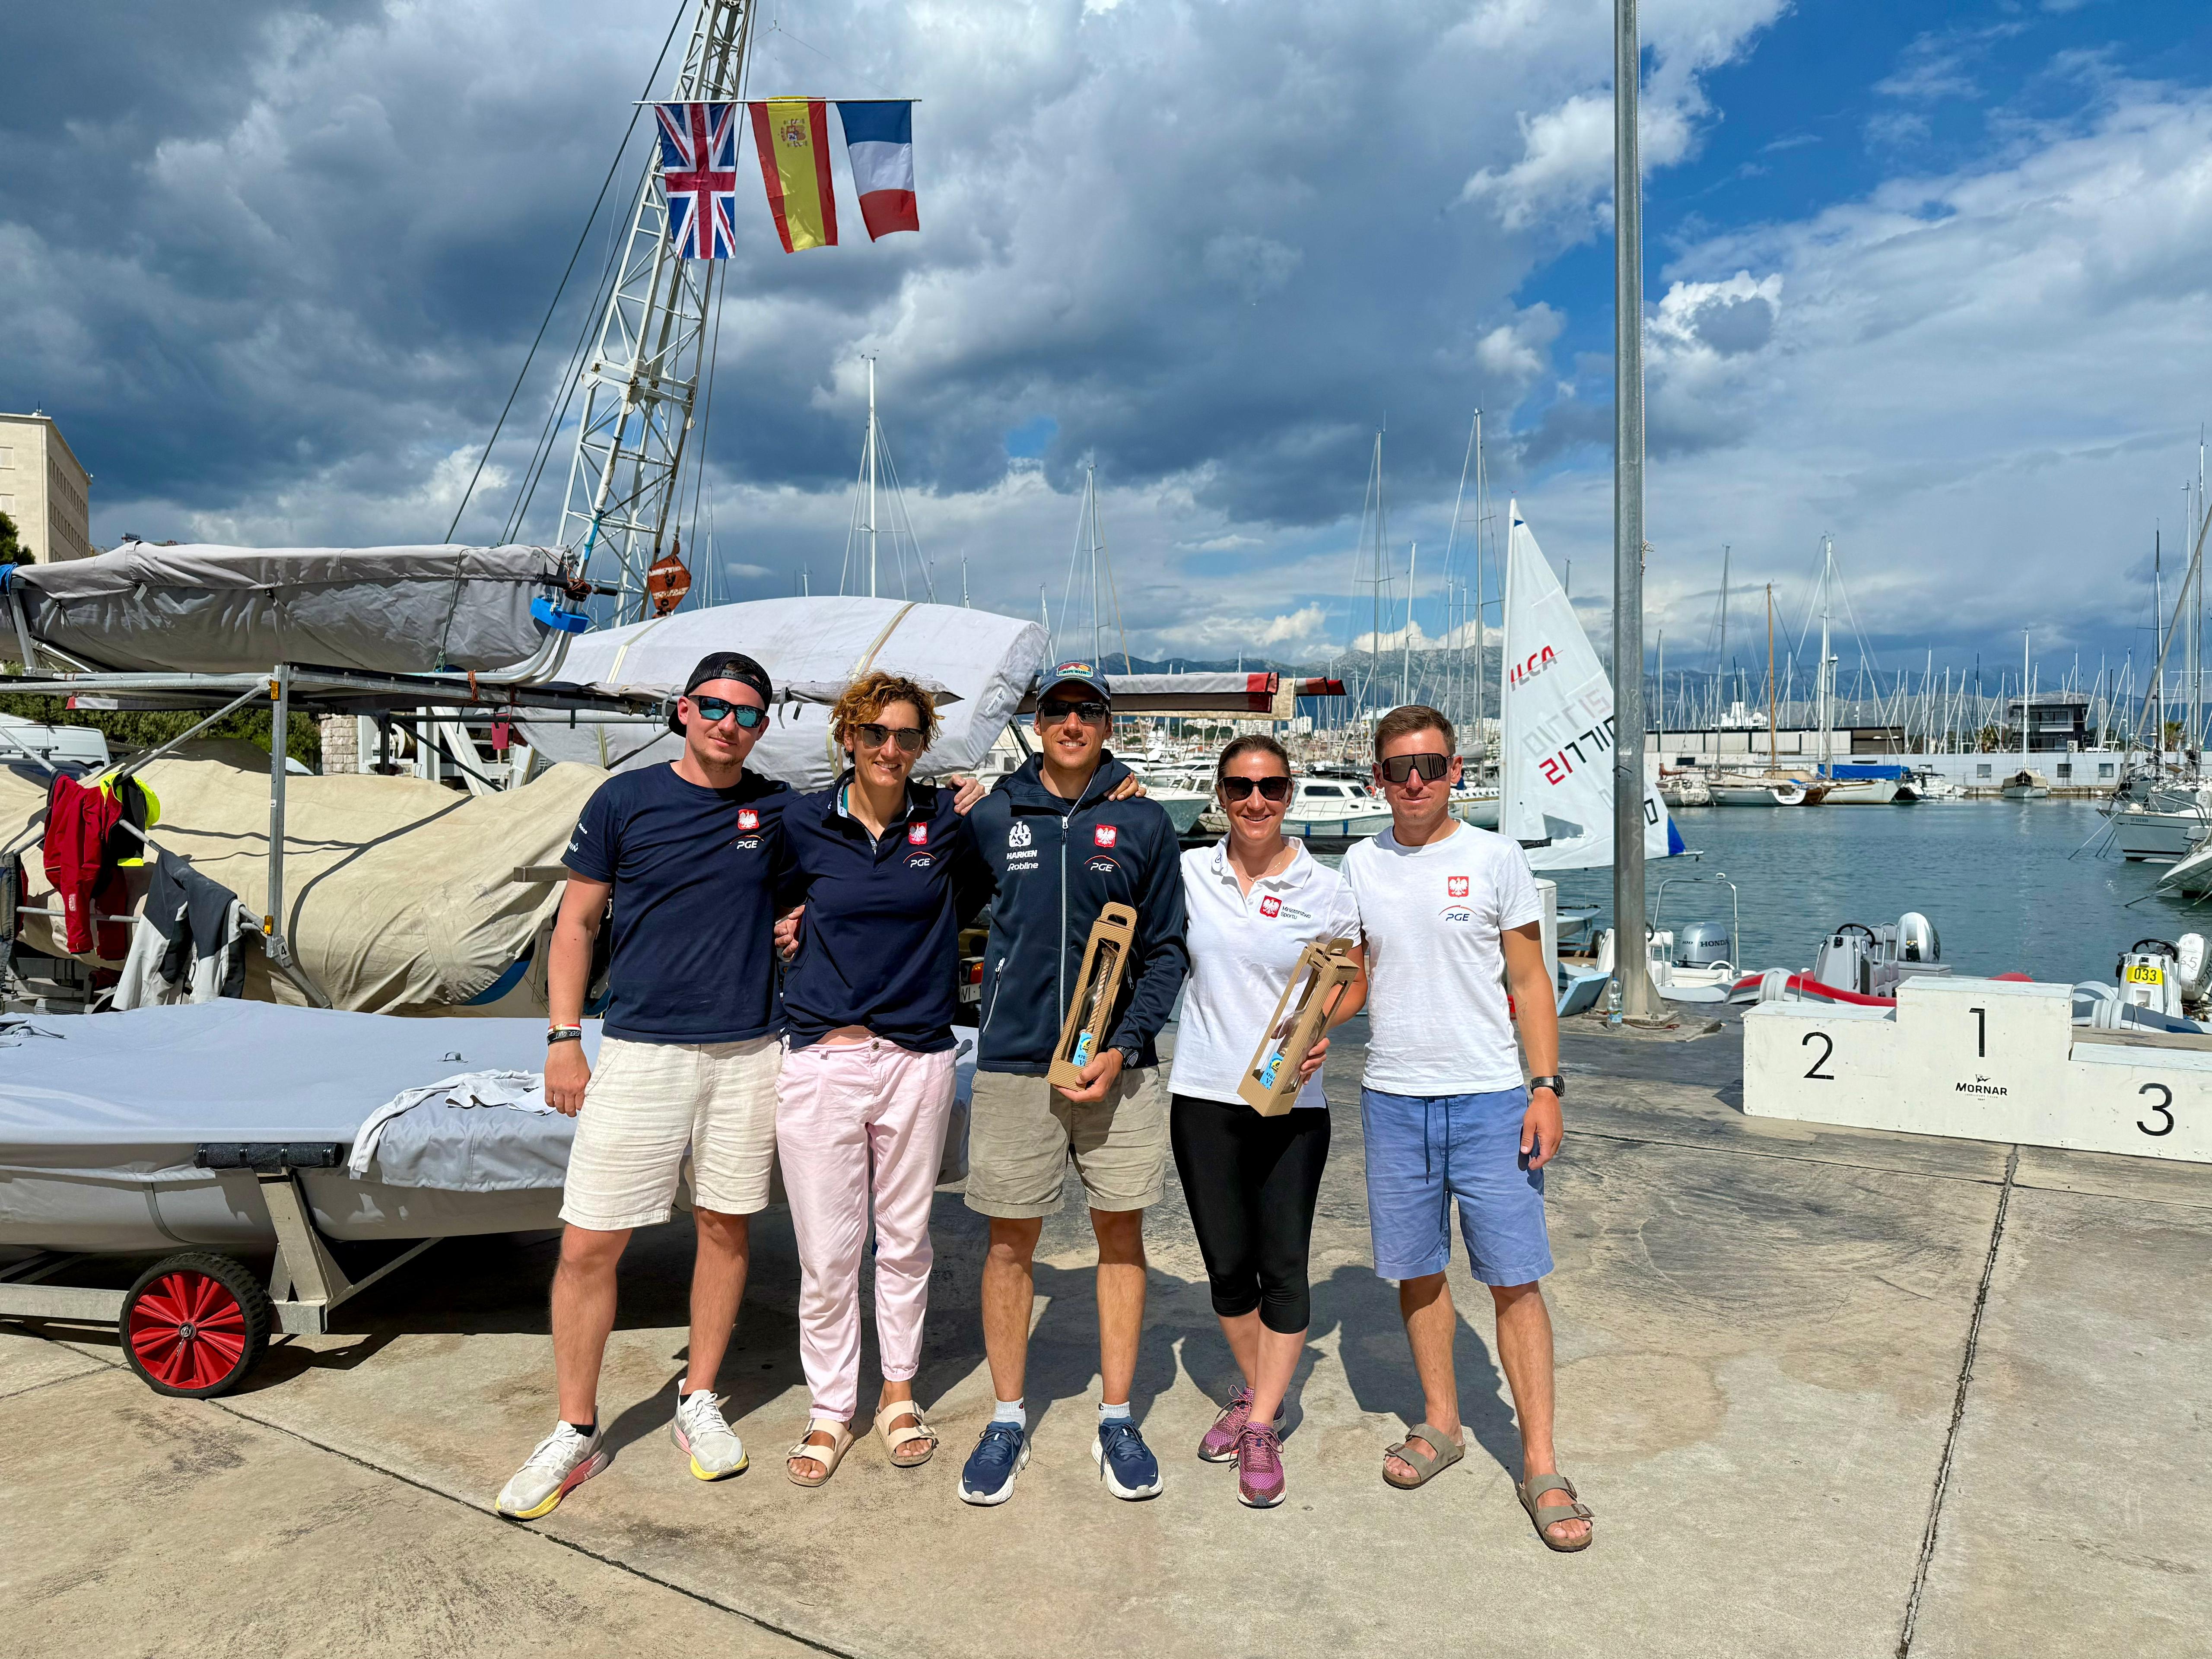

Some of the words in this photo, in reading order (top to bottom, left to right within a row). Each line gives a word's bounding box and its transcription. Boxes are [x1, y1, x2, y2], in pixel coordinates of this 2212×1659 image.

[1510, 645, 1558, 692] ILCA
[736, 840, 758, 850] PGE
[1006, 849, 1038, 860] HARKEN
[910, 858, 931, 868] PGE
[1007, 862, 1039, 871] Robline
[1090, 862, 1114, 872] PGE
[1281, 911, 1297, 920] Sportu
[1282, 906, 1311, 919] Ministerstwo
[1700, 939, 1729, 947] HONDA
[281, 945, 287, 955] 4
[2134, 968, 2157, 982] 033
[1969, 1007, 1985, 1058] 1
[1802, 1031, 1835, 1080] 2
[1955, 1082, 2008, 1096] MORNAR
[2136, 1083, 2175, 1136] 3
